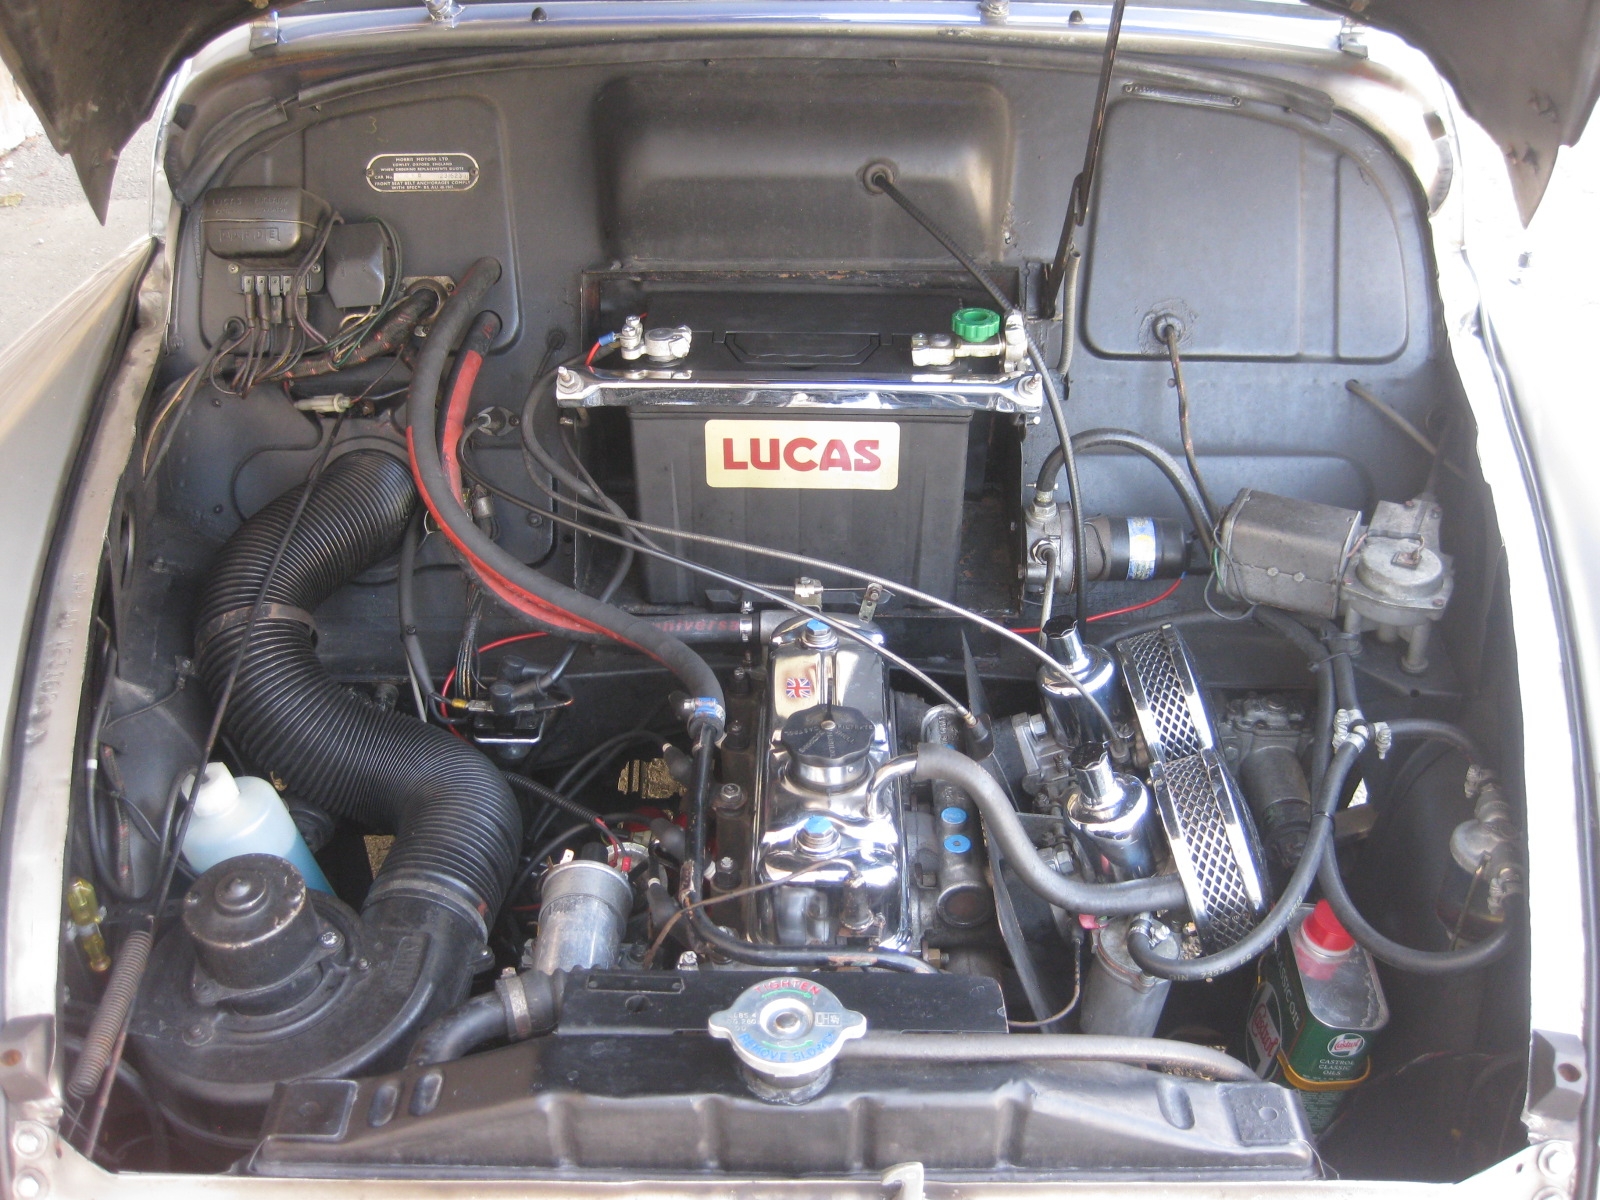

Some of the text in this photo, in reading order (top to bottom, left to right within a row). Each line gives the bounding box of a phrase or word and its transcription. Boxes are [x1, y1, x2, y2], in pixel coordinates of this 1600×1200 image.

[723, 437, 881, 472] LUCAS
[652, 620, 740, 632] niversa
[754, 979, 821, 995] TIGHTEN
[1252, 1003, 1280, 1057] Castrol
[1288, 1001, 1301, 1031] OIL
[737, 1032, 788, 1062] REMOVE
[793, 1031, 836, 1061] SLOWLY
[1333, 1037, 1362, 1051] Castrol
[1319, 1058, 1354, 1066] CASTROL
